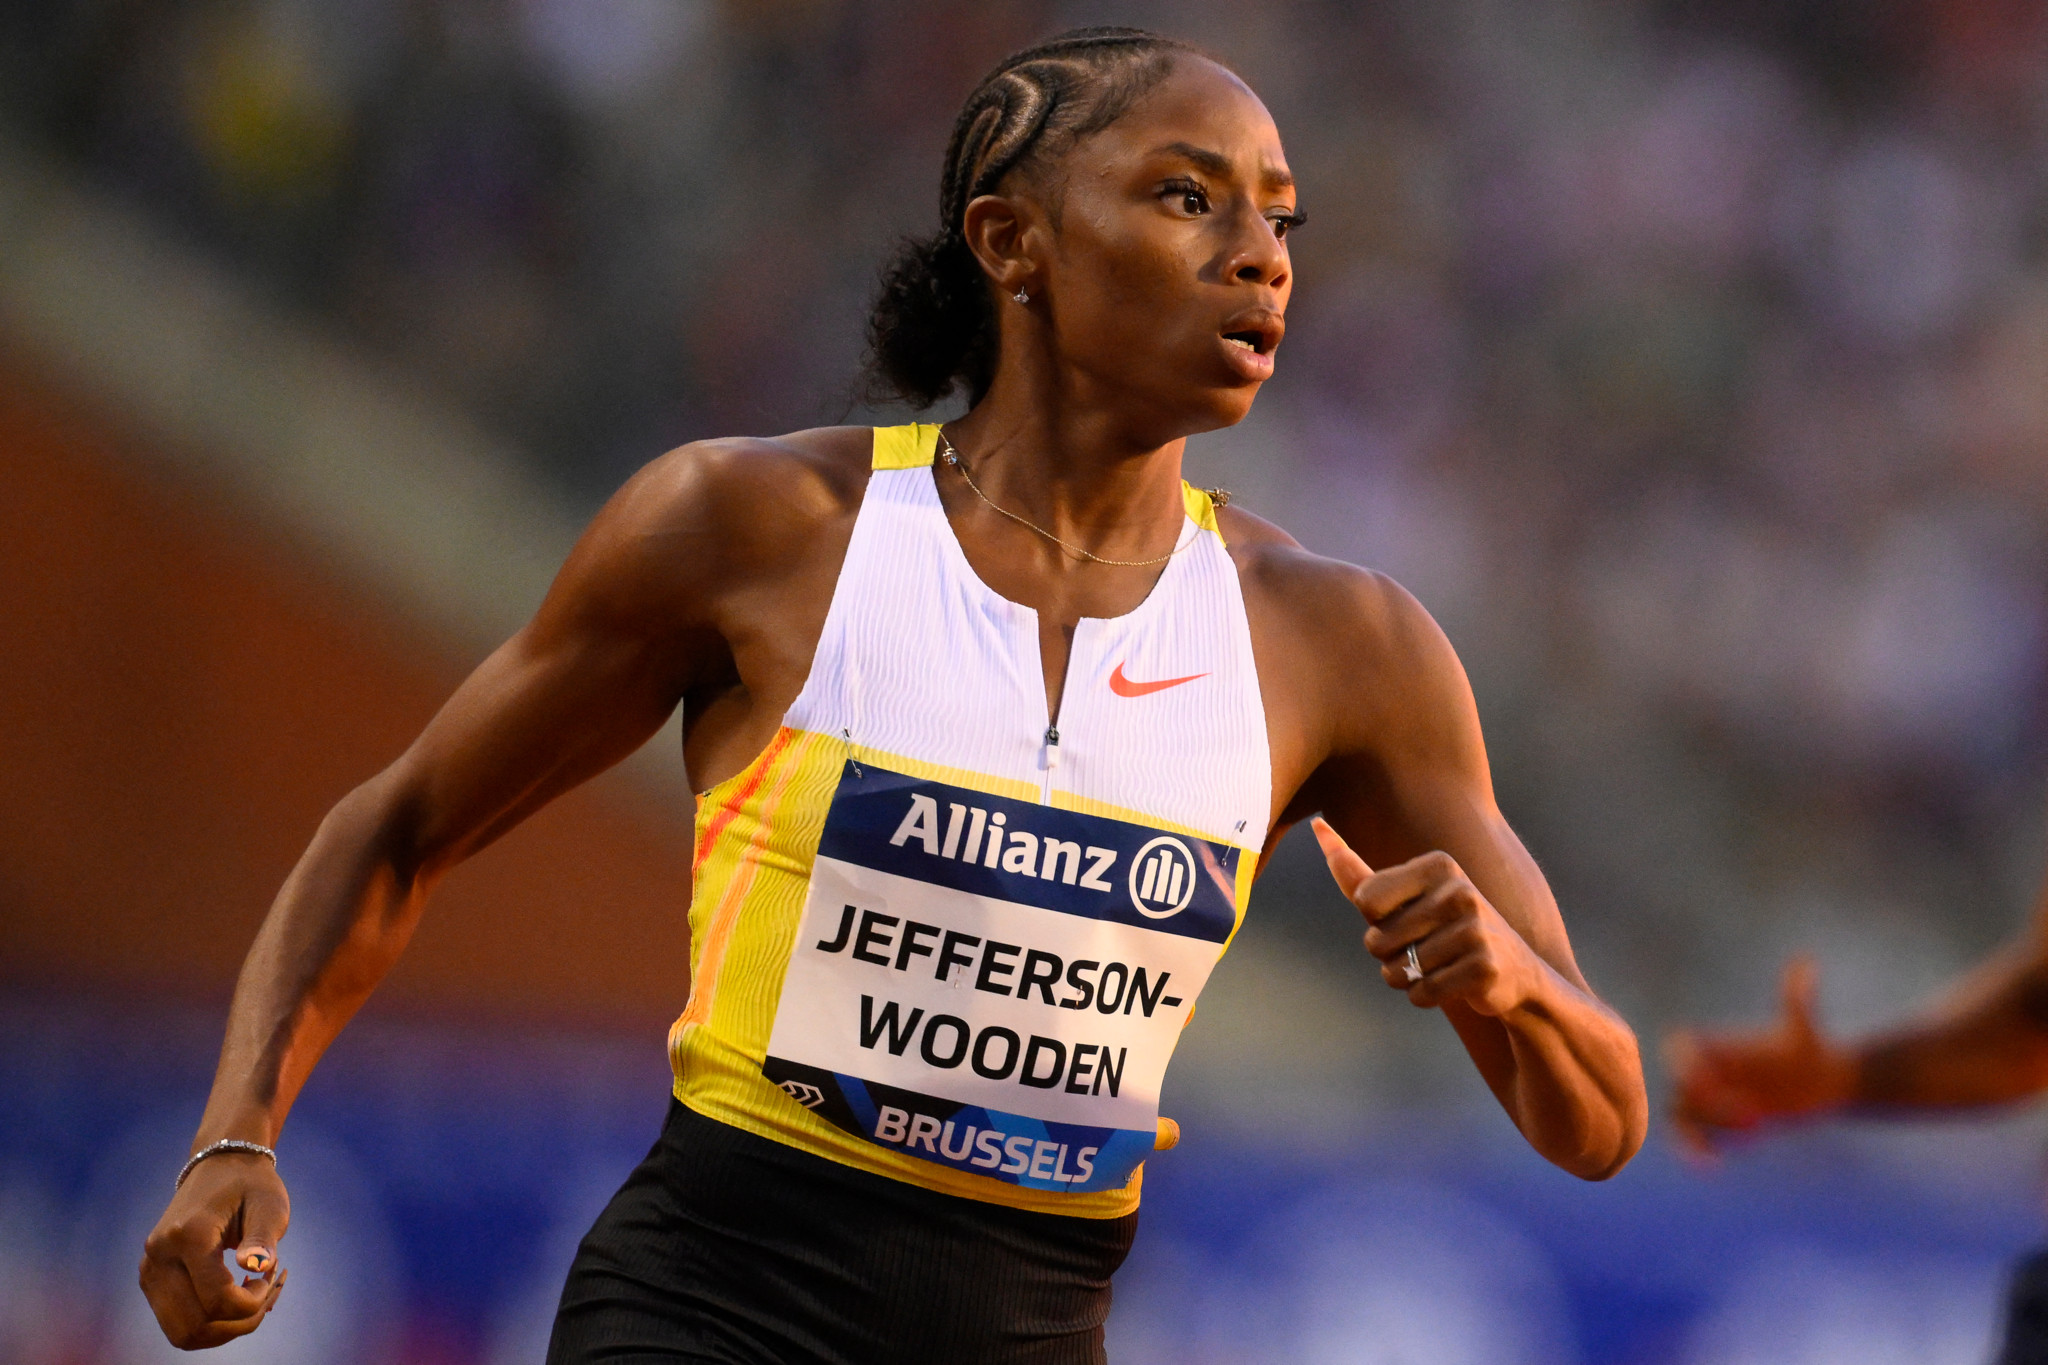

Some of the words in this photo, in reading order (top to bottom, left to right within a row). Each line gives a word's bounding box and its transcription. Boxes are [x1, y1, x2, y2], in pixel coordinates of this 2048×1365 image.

[890, 793, 1117, 892] Allianz
[816, 904, 1183, 1018] JEFFERSON-
[859, 994, 1127, 1098] WOODEN
[874, 1105, 1098, 1184] BRUSSELS
